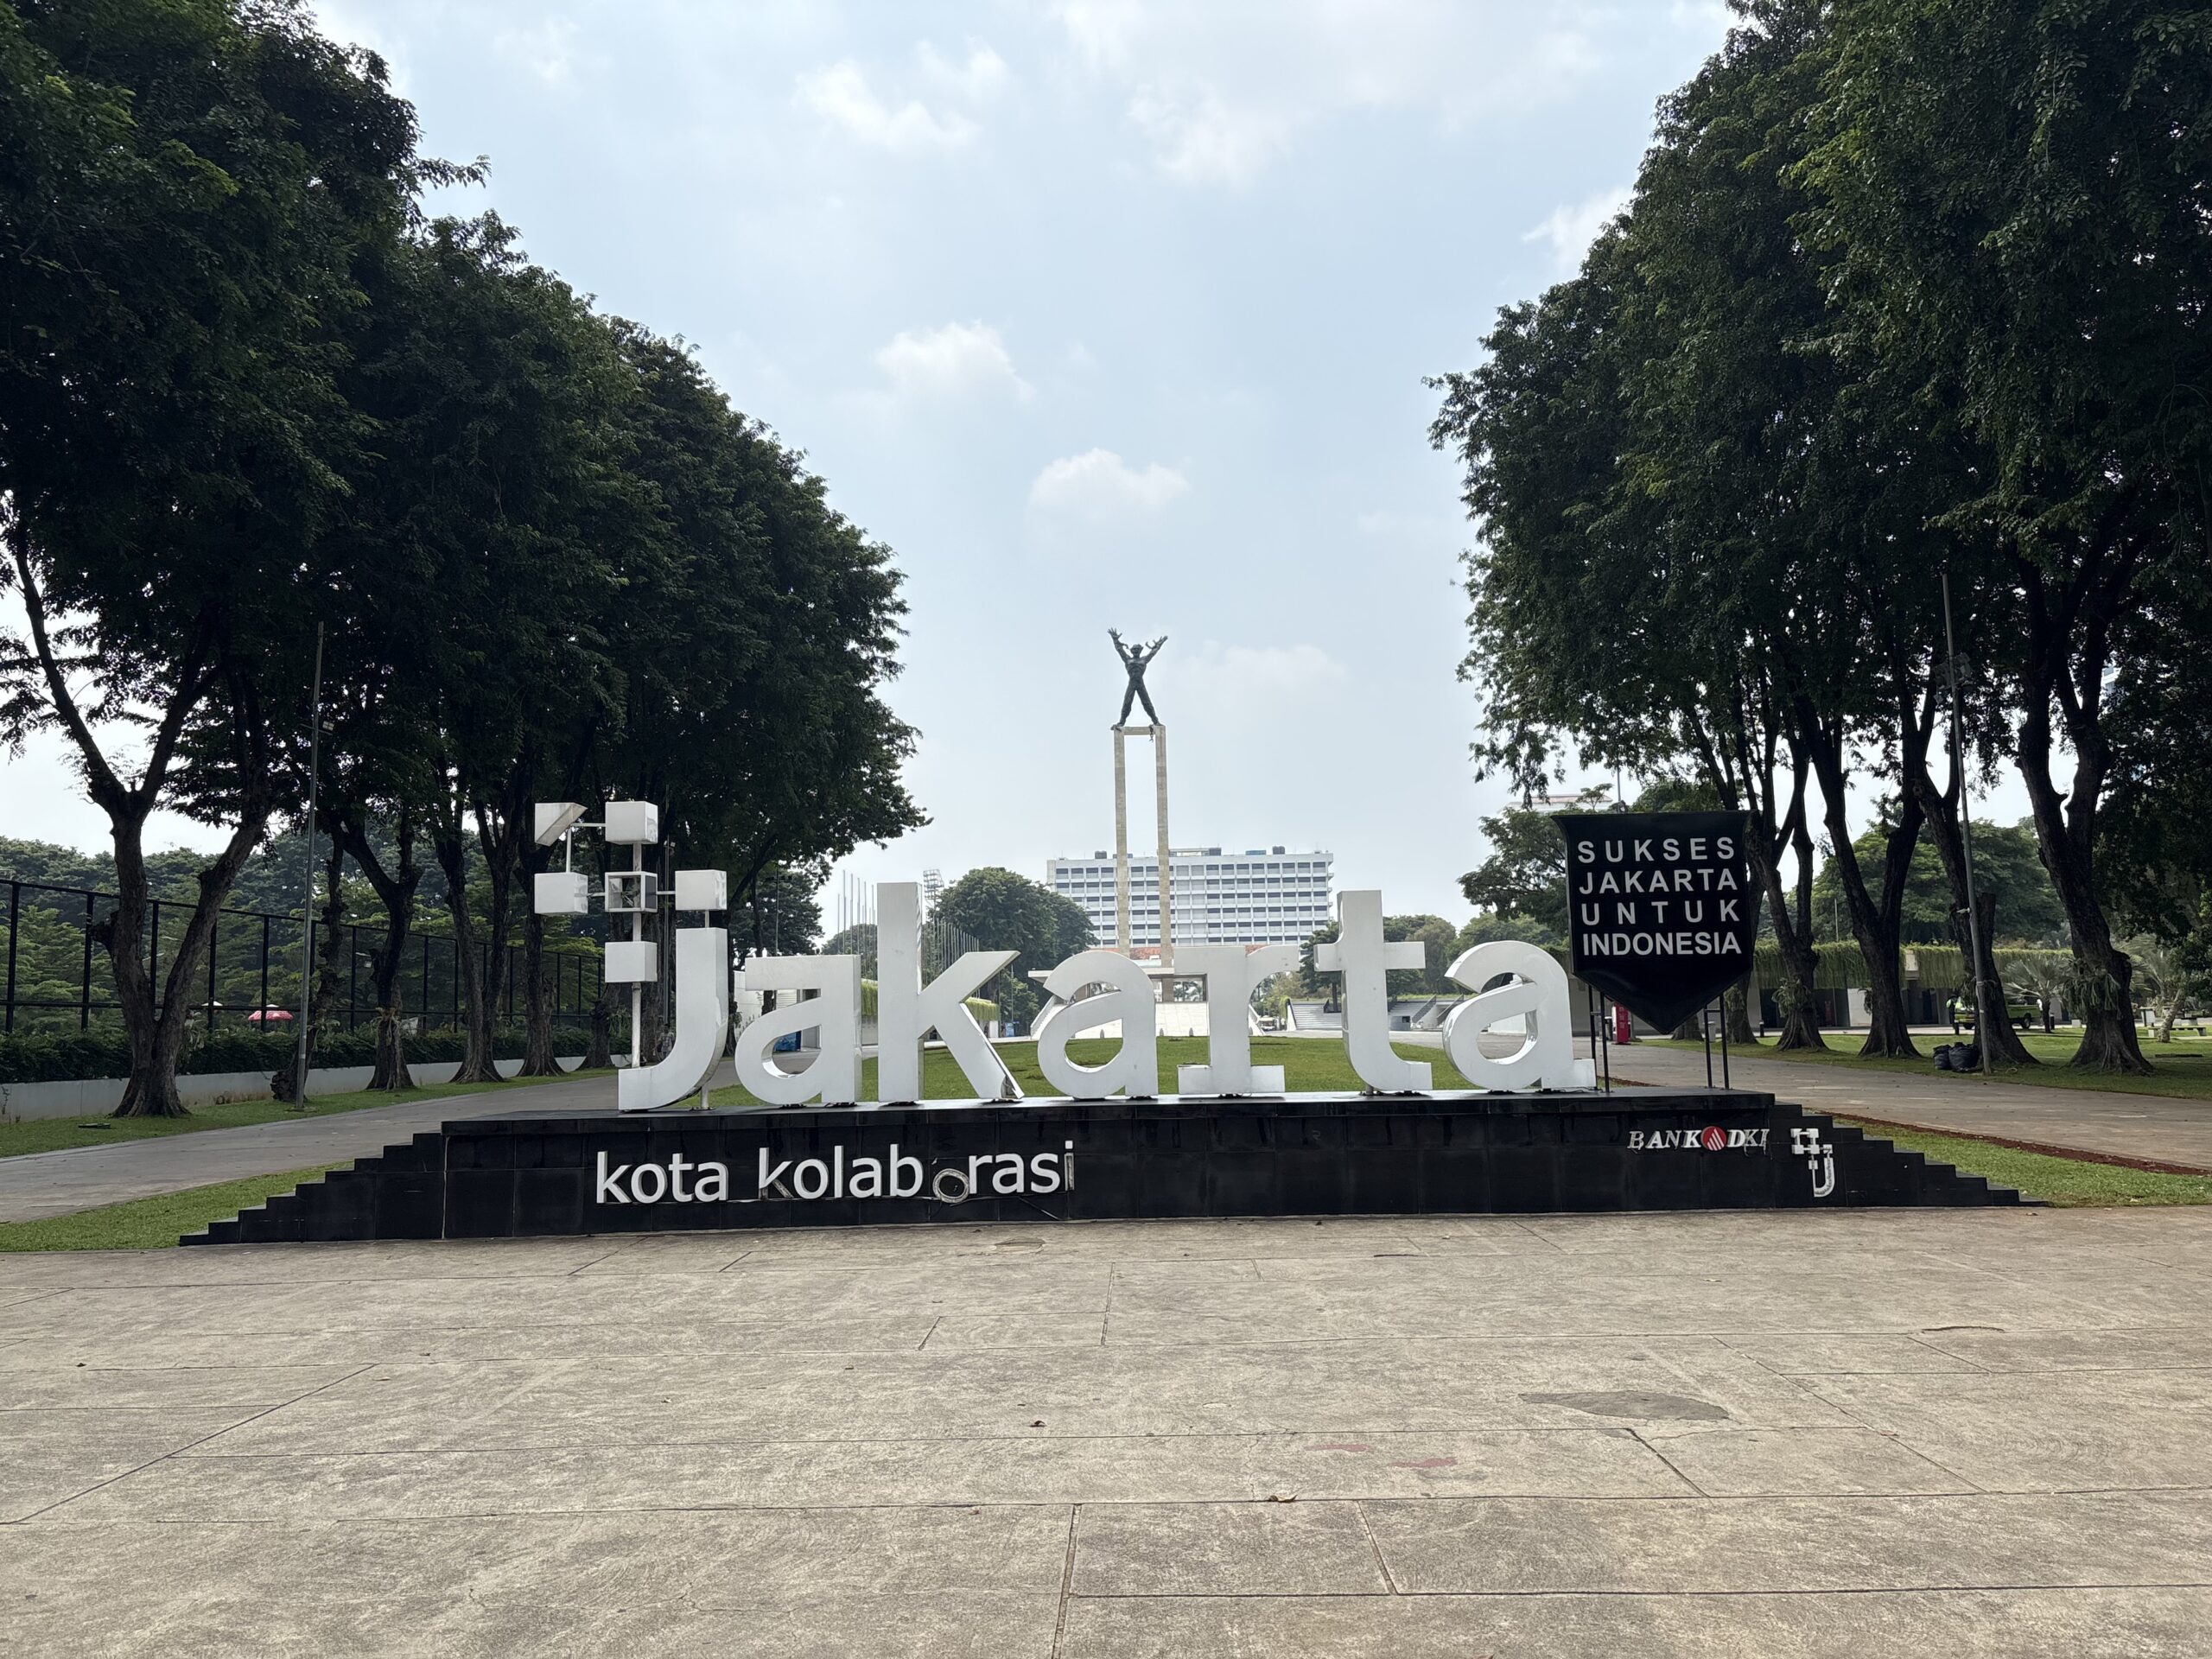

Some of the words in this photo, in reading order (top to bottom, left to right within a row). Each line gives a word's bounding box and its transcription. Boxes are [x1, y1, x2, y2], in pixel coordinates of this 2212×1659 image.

[1577, 836, 1735, 863] SUKSES
[1579, 868, 1738, 895] JAKARTA
[1581, 899, 1740, 925] UNTUK
[1583, 931, 1742, 957] INDONESIA
[1627, 1129, 1702, 1150] BANK
[1726, 1128, 1770, 1150] DKI
[596, 1150, 729, 1205] kota
[759, 1141, 1075, 1204] kolaborasi
